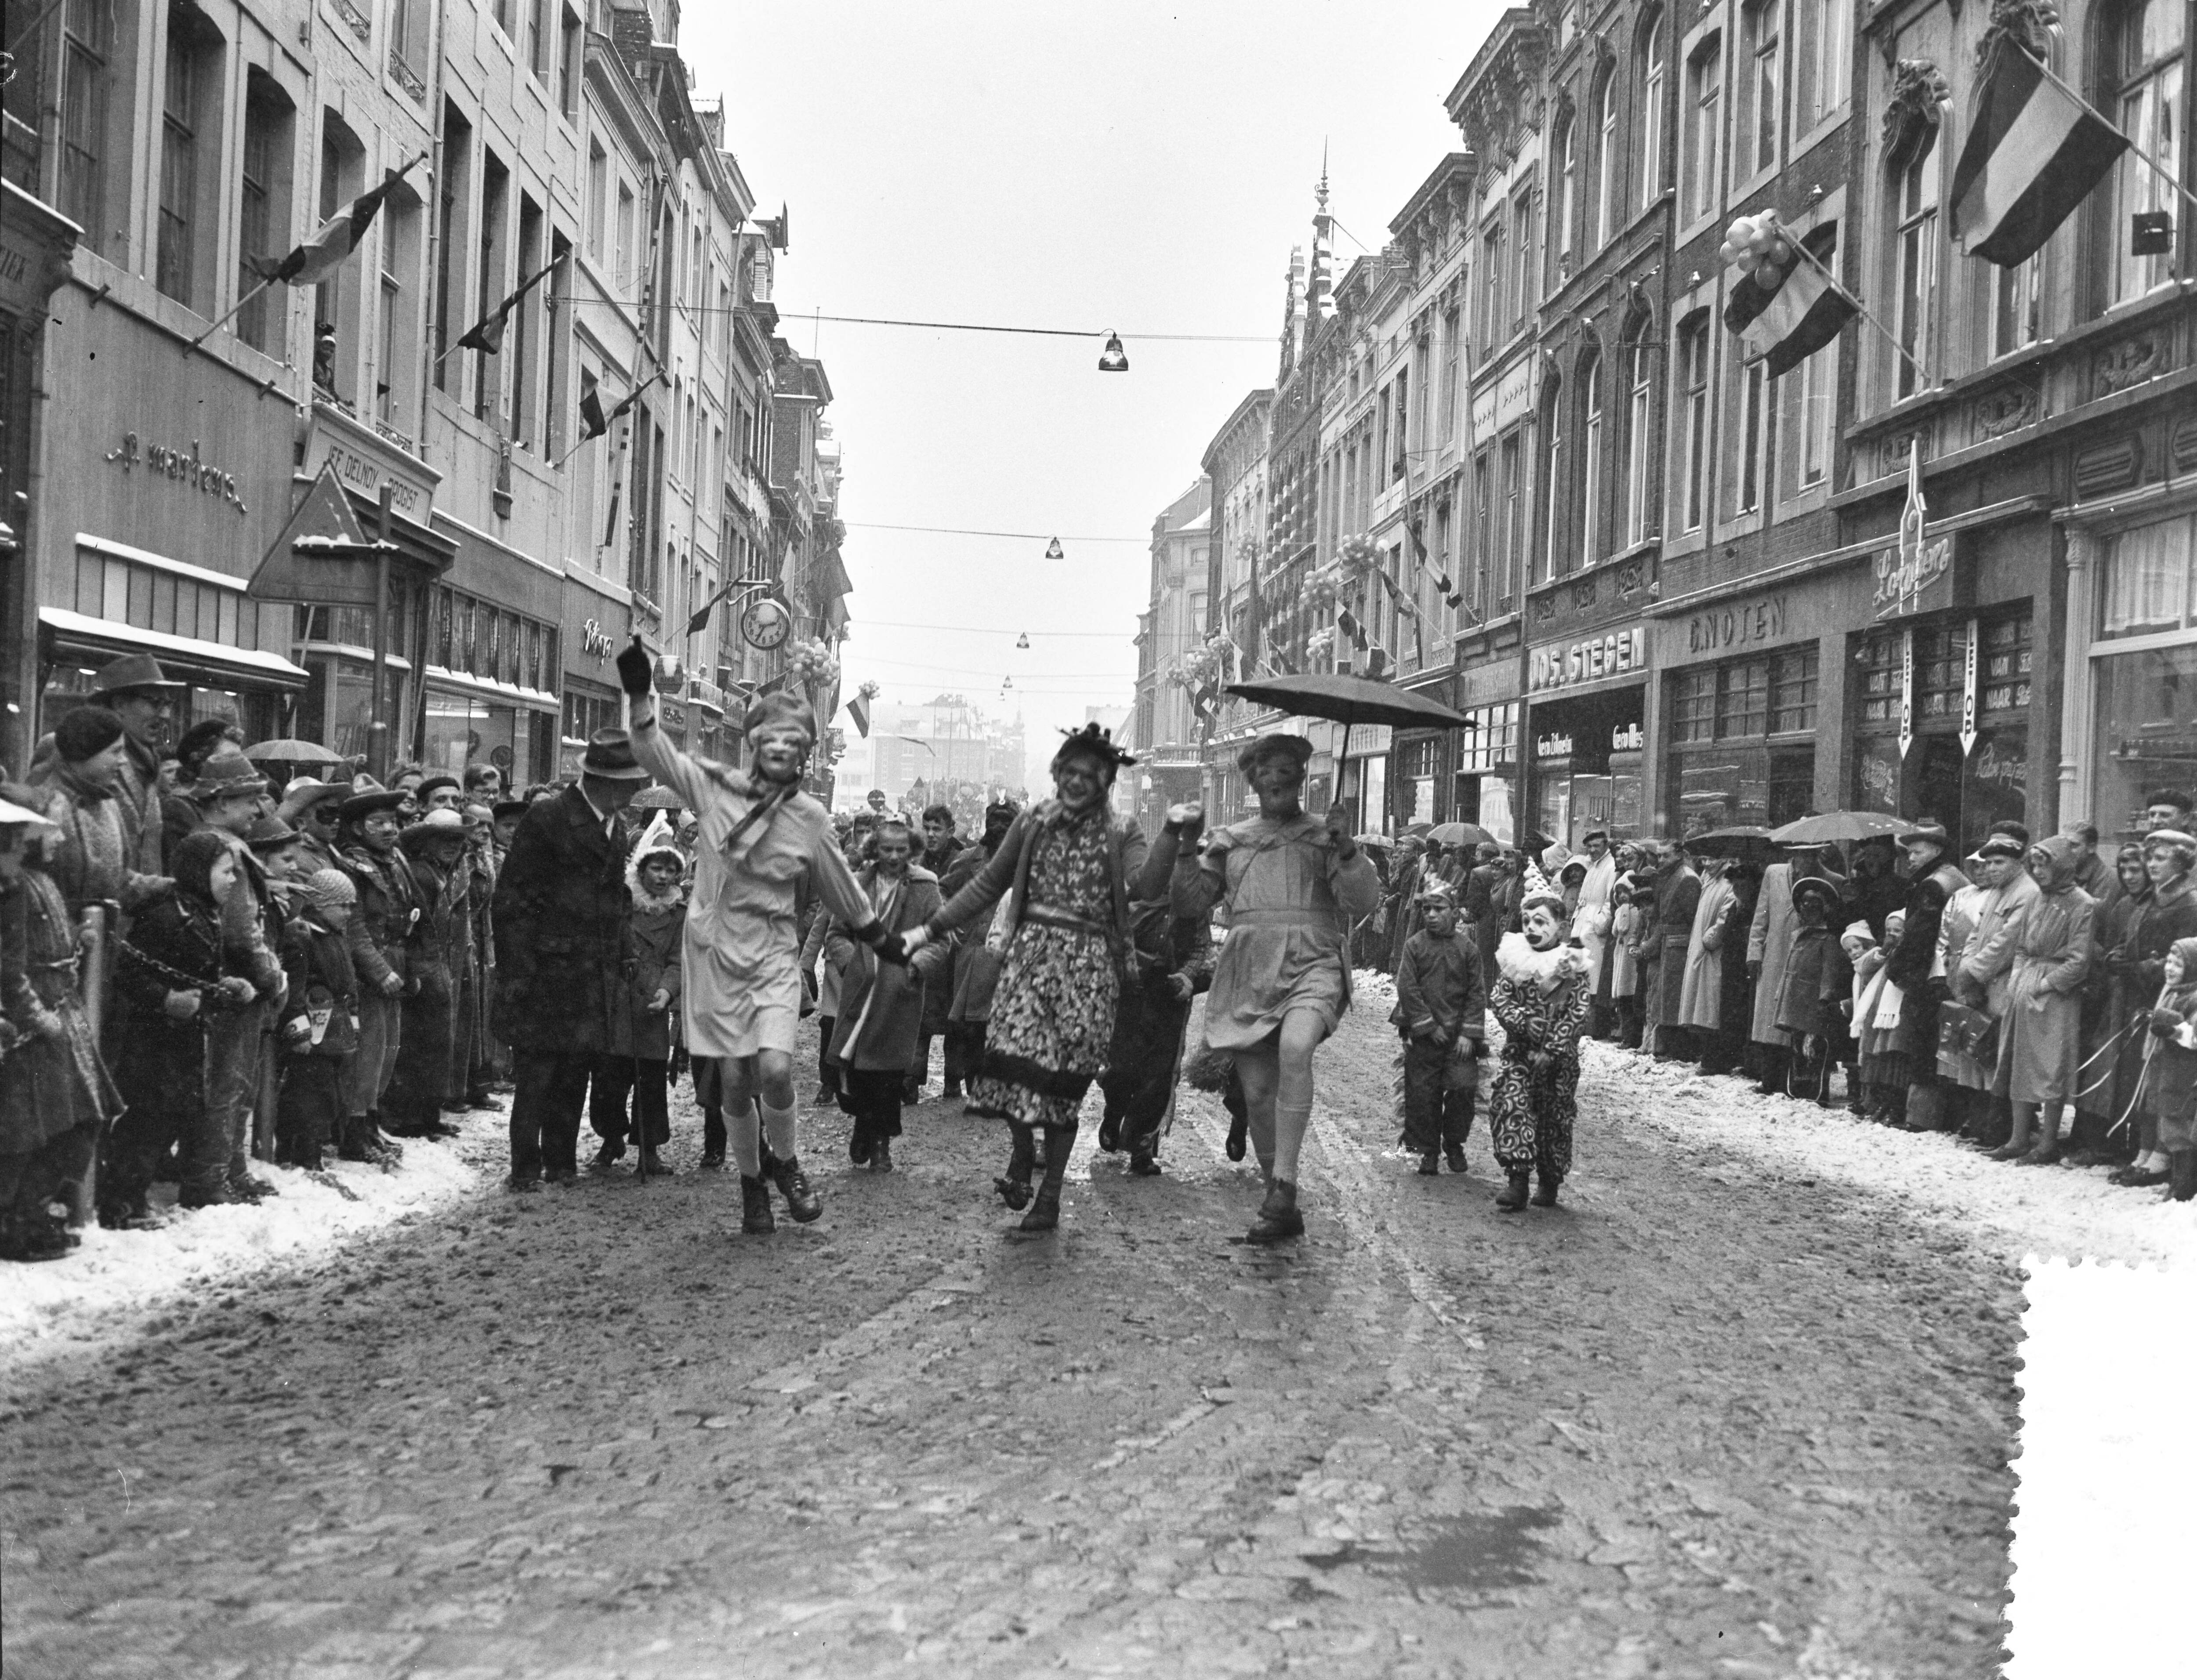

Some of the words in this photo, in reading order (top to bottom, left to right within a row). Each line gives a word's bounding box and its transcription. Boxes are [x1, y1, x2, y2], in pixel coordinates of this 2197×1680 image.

[344, 455, 379, 490] DELNOY
[388, 477, 418, 513] DROGIST
[1570, 626, 1645, 681] STEGEN
[1964, 694, 1973, 742] OP
